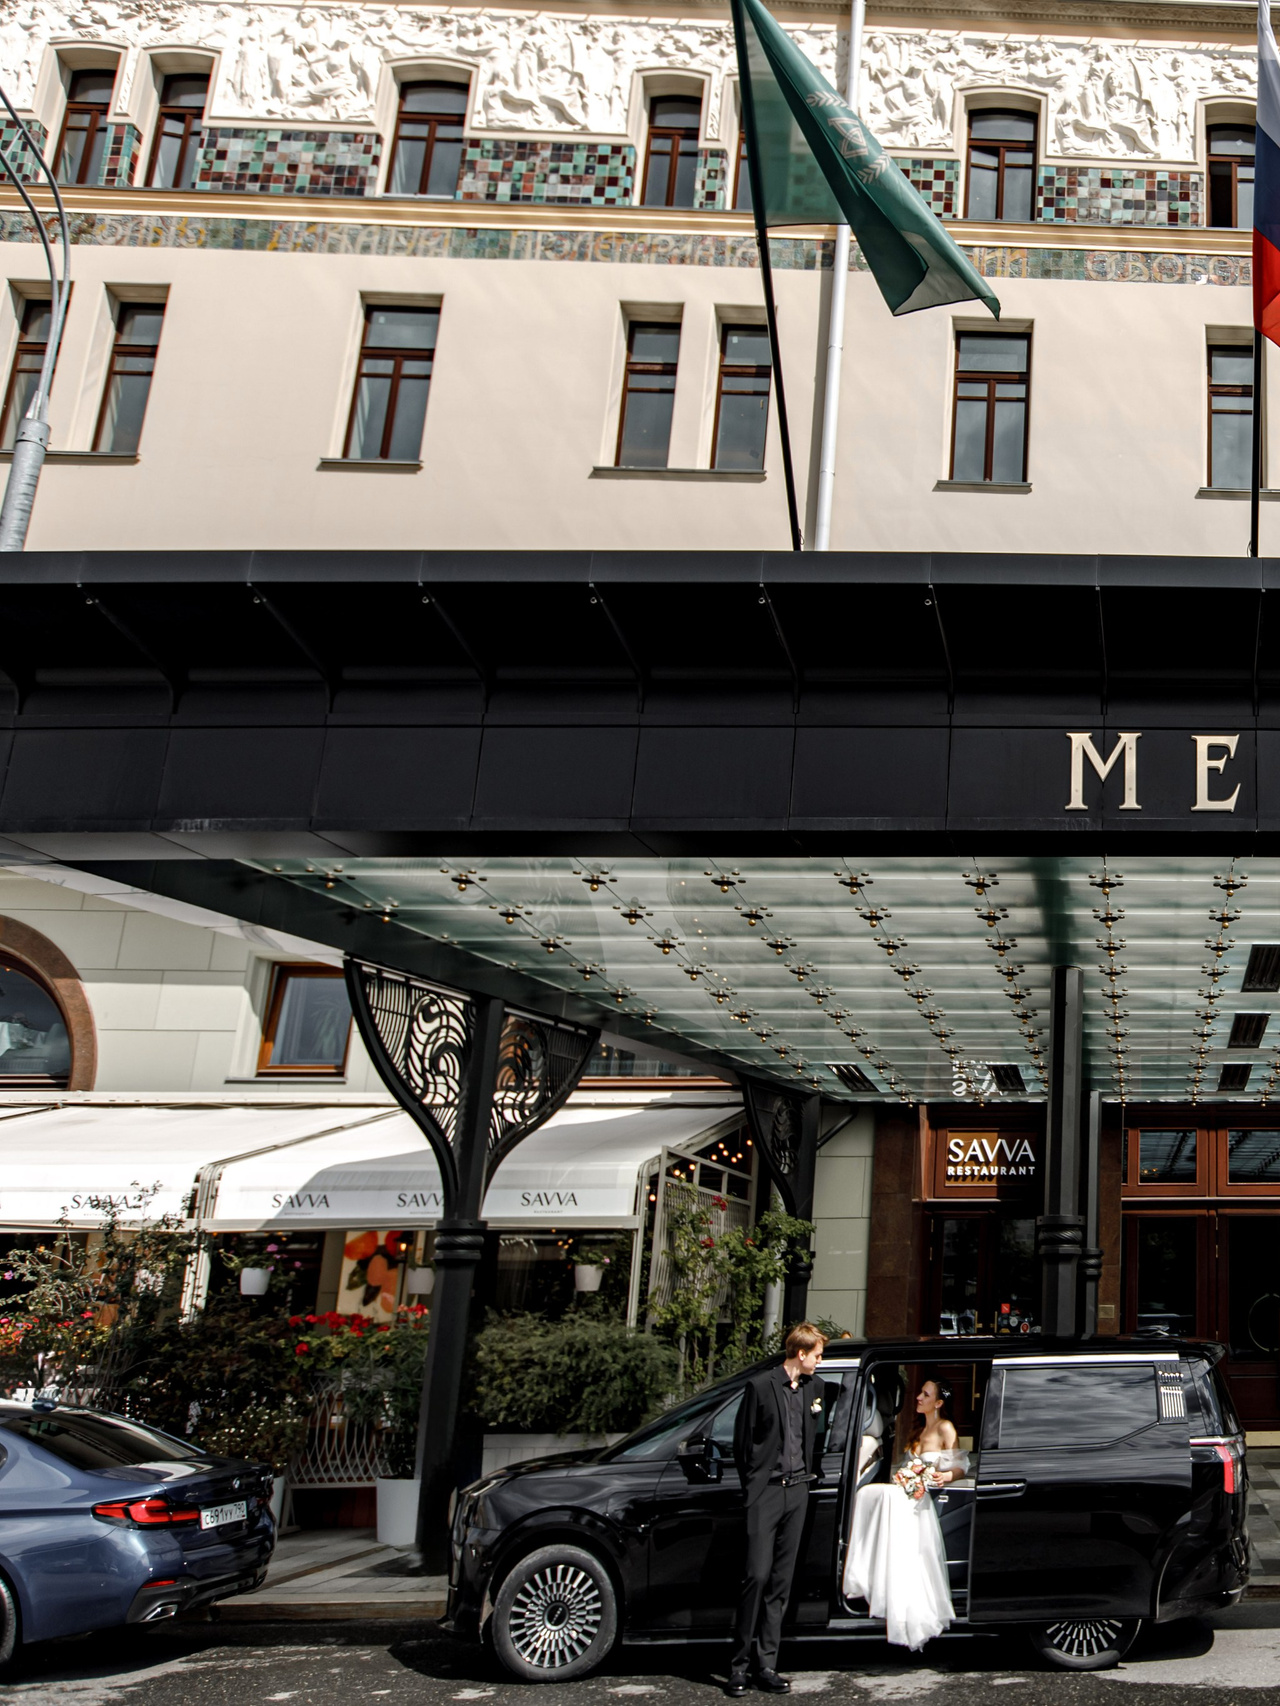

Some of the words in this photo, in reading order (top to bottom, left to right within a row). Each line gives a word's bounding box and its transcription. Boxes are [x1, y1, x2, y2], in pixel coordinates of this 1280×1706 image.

[948, 1138, 1035, 1163] SAVVA
[947, 1166, 1035, 1176] RESTAURANT
[271, 1194, 330, 1208] SAVVA
[396, 1193, 444, 1207] SAVV
[520, 1192, 578, 1207] SAVVA
